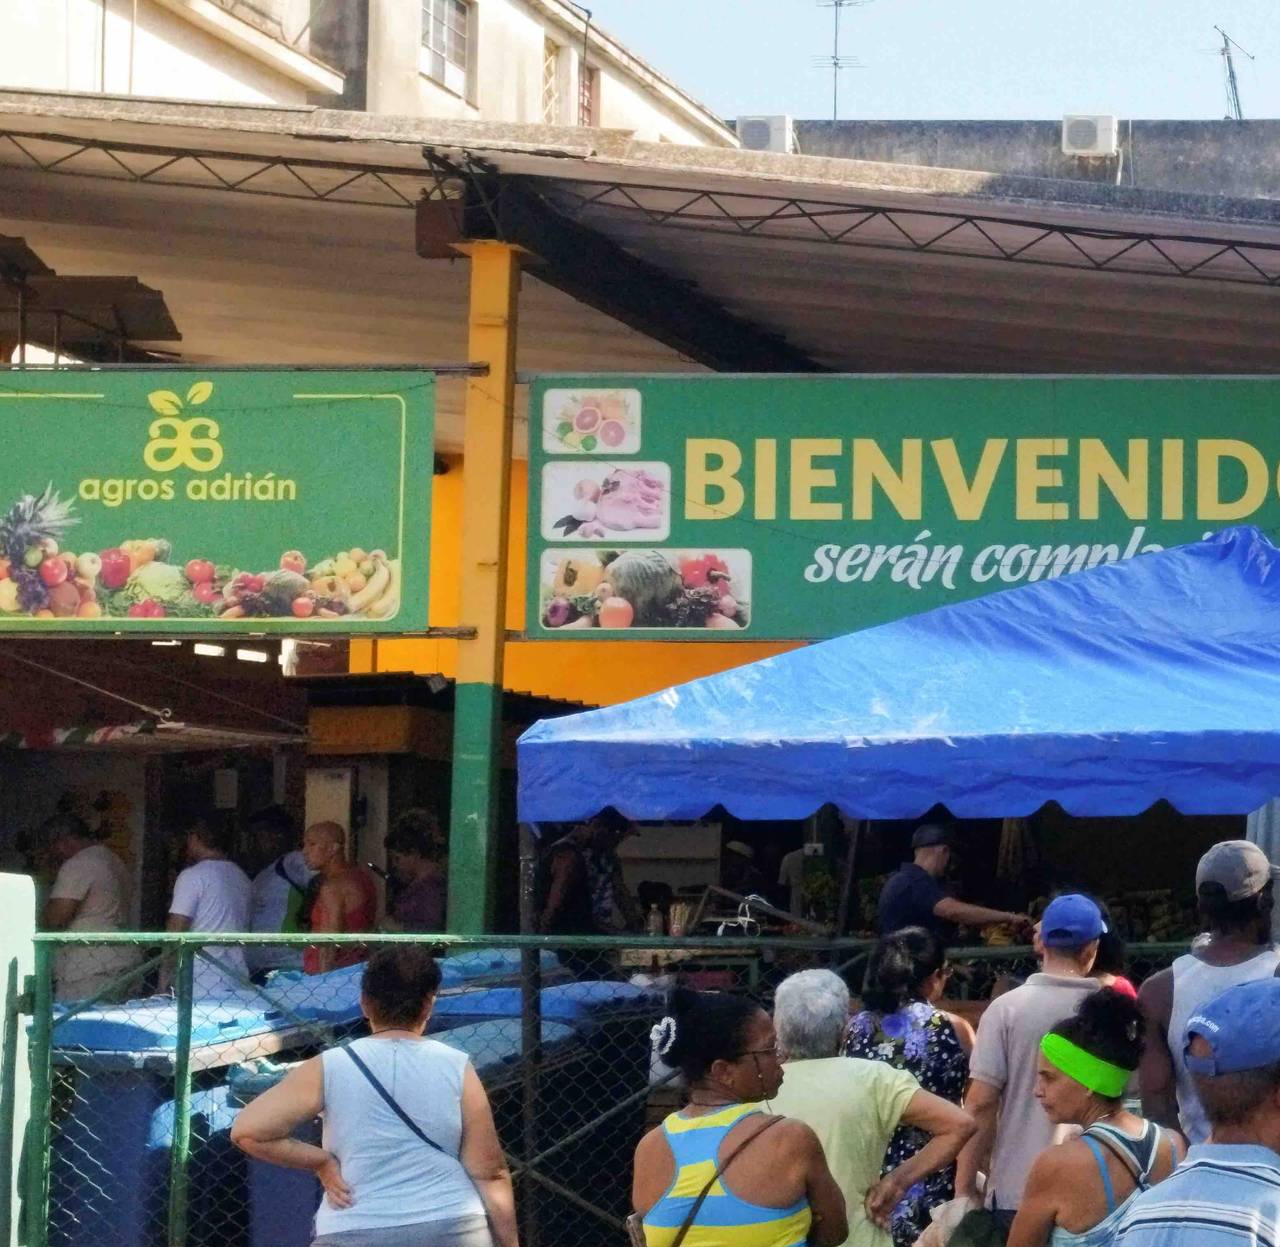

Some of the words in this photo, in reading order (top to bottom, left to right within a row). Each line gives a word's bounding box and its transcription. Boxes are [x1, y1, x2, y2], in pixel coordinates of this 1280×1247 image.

[79, 479, 175, 507] agros
[186, 472, 296, 500] adrián
[804, 530, 963, 590] serán
